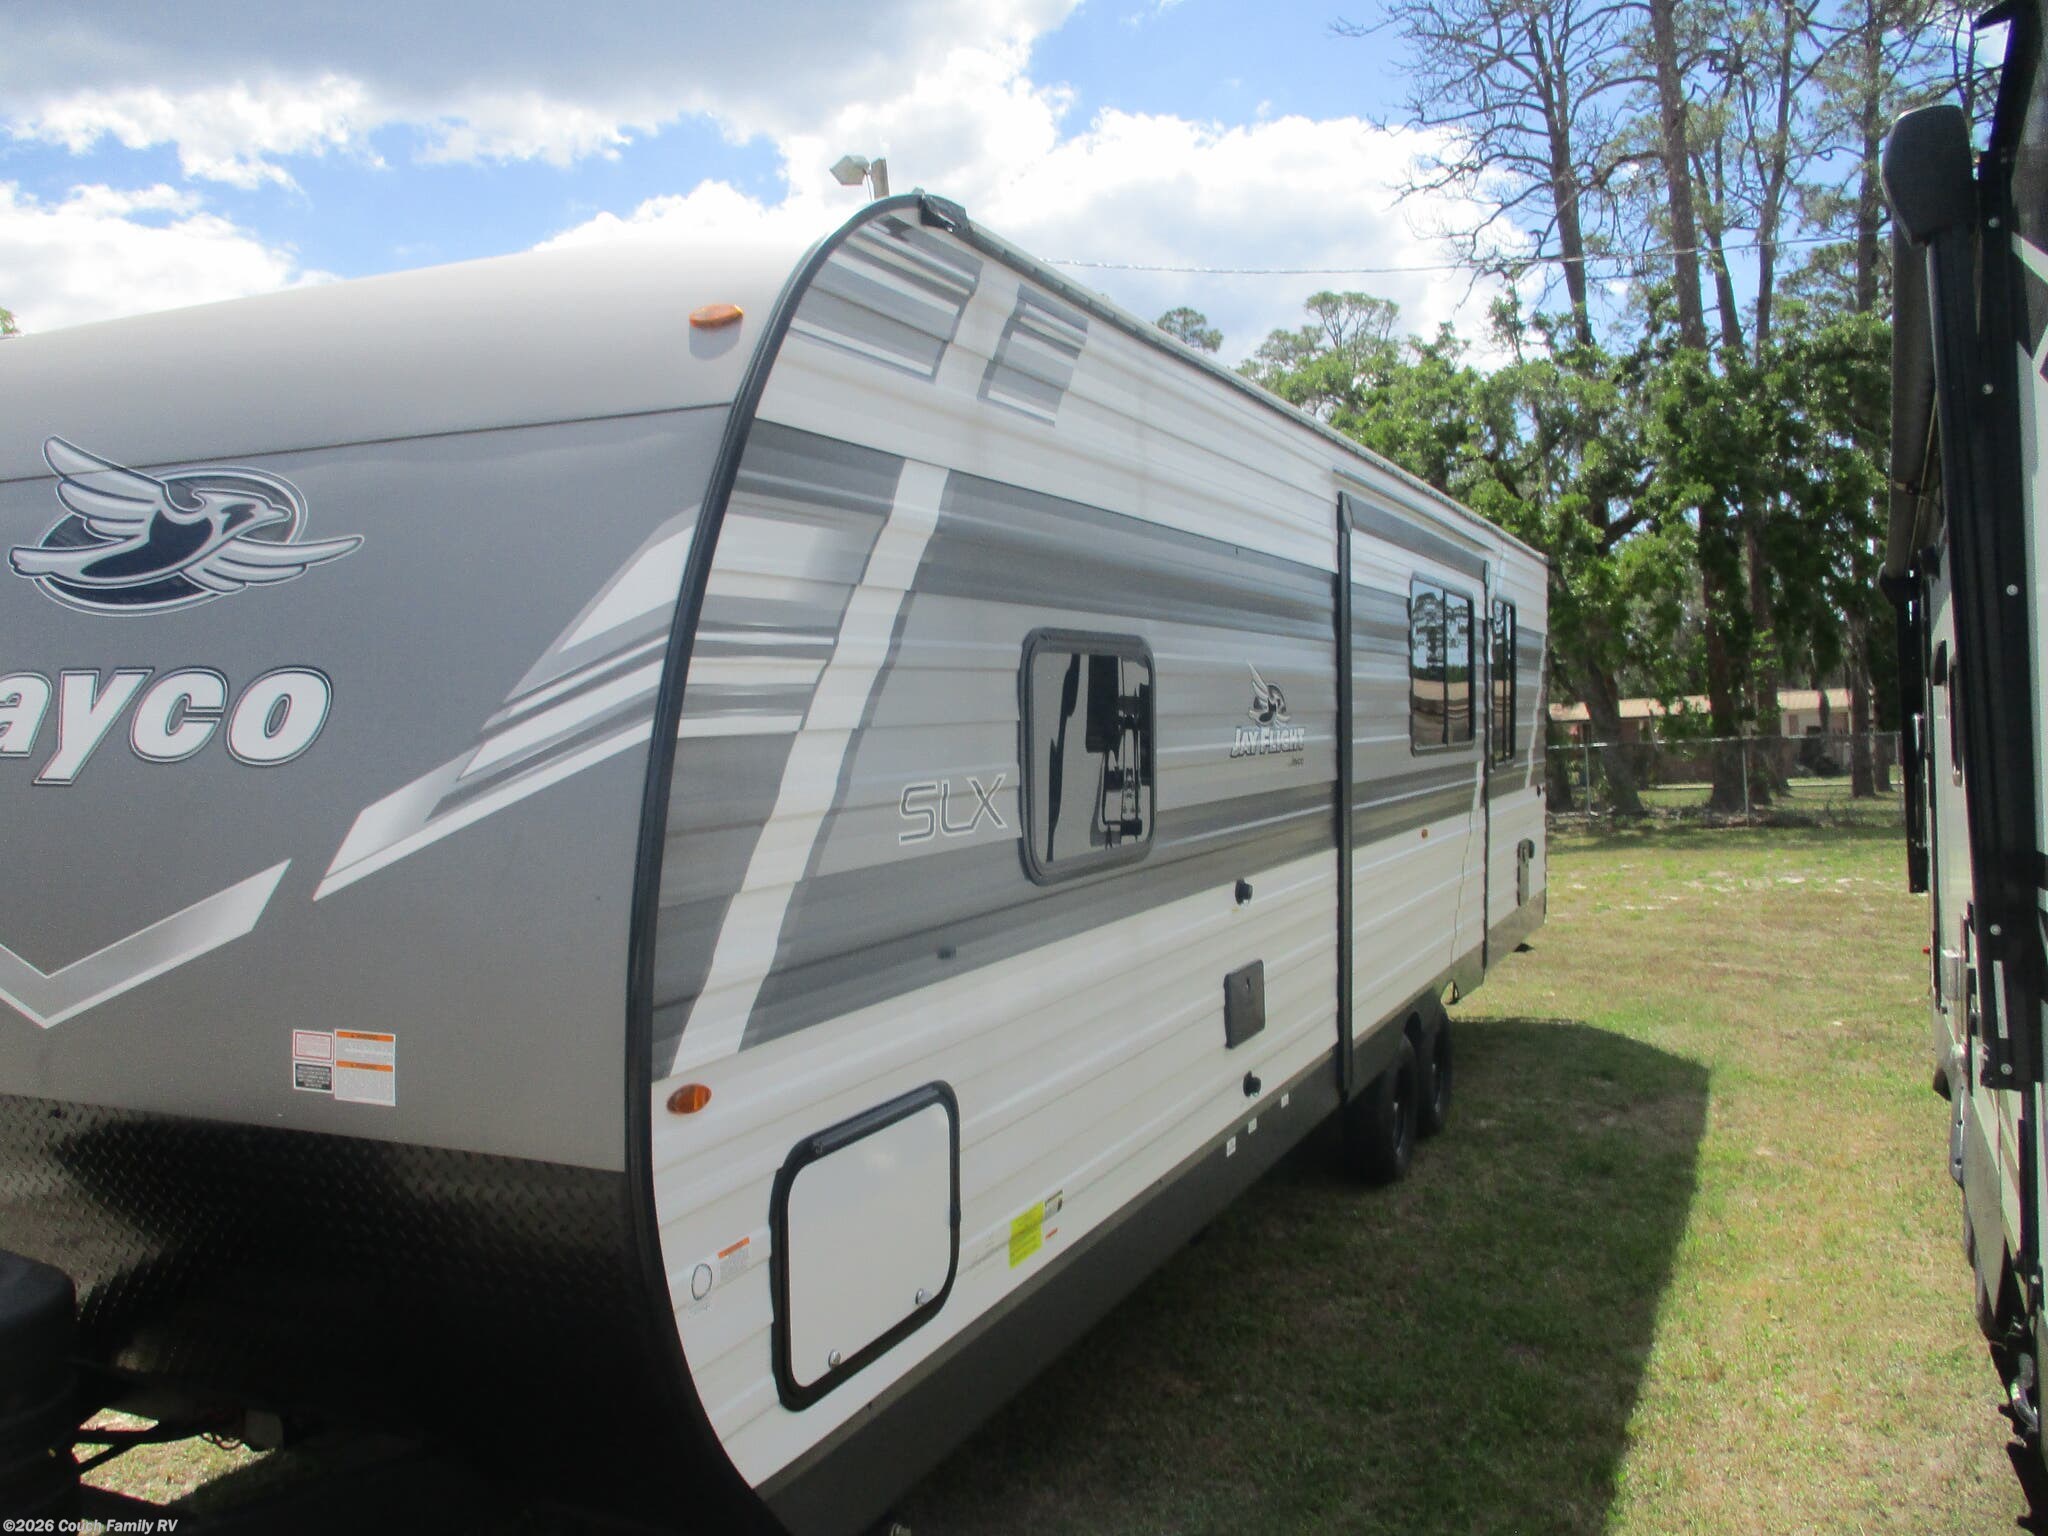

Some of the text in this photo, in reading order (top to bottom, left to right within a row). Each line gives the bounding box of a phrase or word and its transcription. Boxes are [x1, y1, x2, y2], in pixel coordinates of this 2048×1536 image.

[1230, 726, 1305, 758] JAY FLIGHT
[899, 774, 1008, 845] SLX
